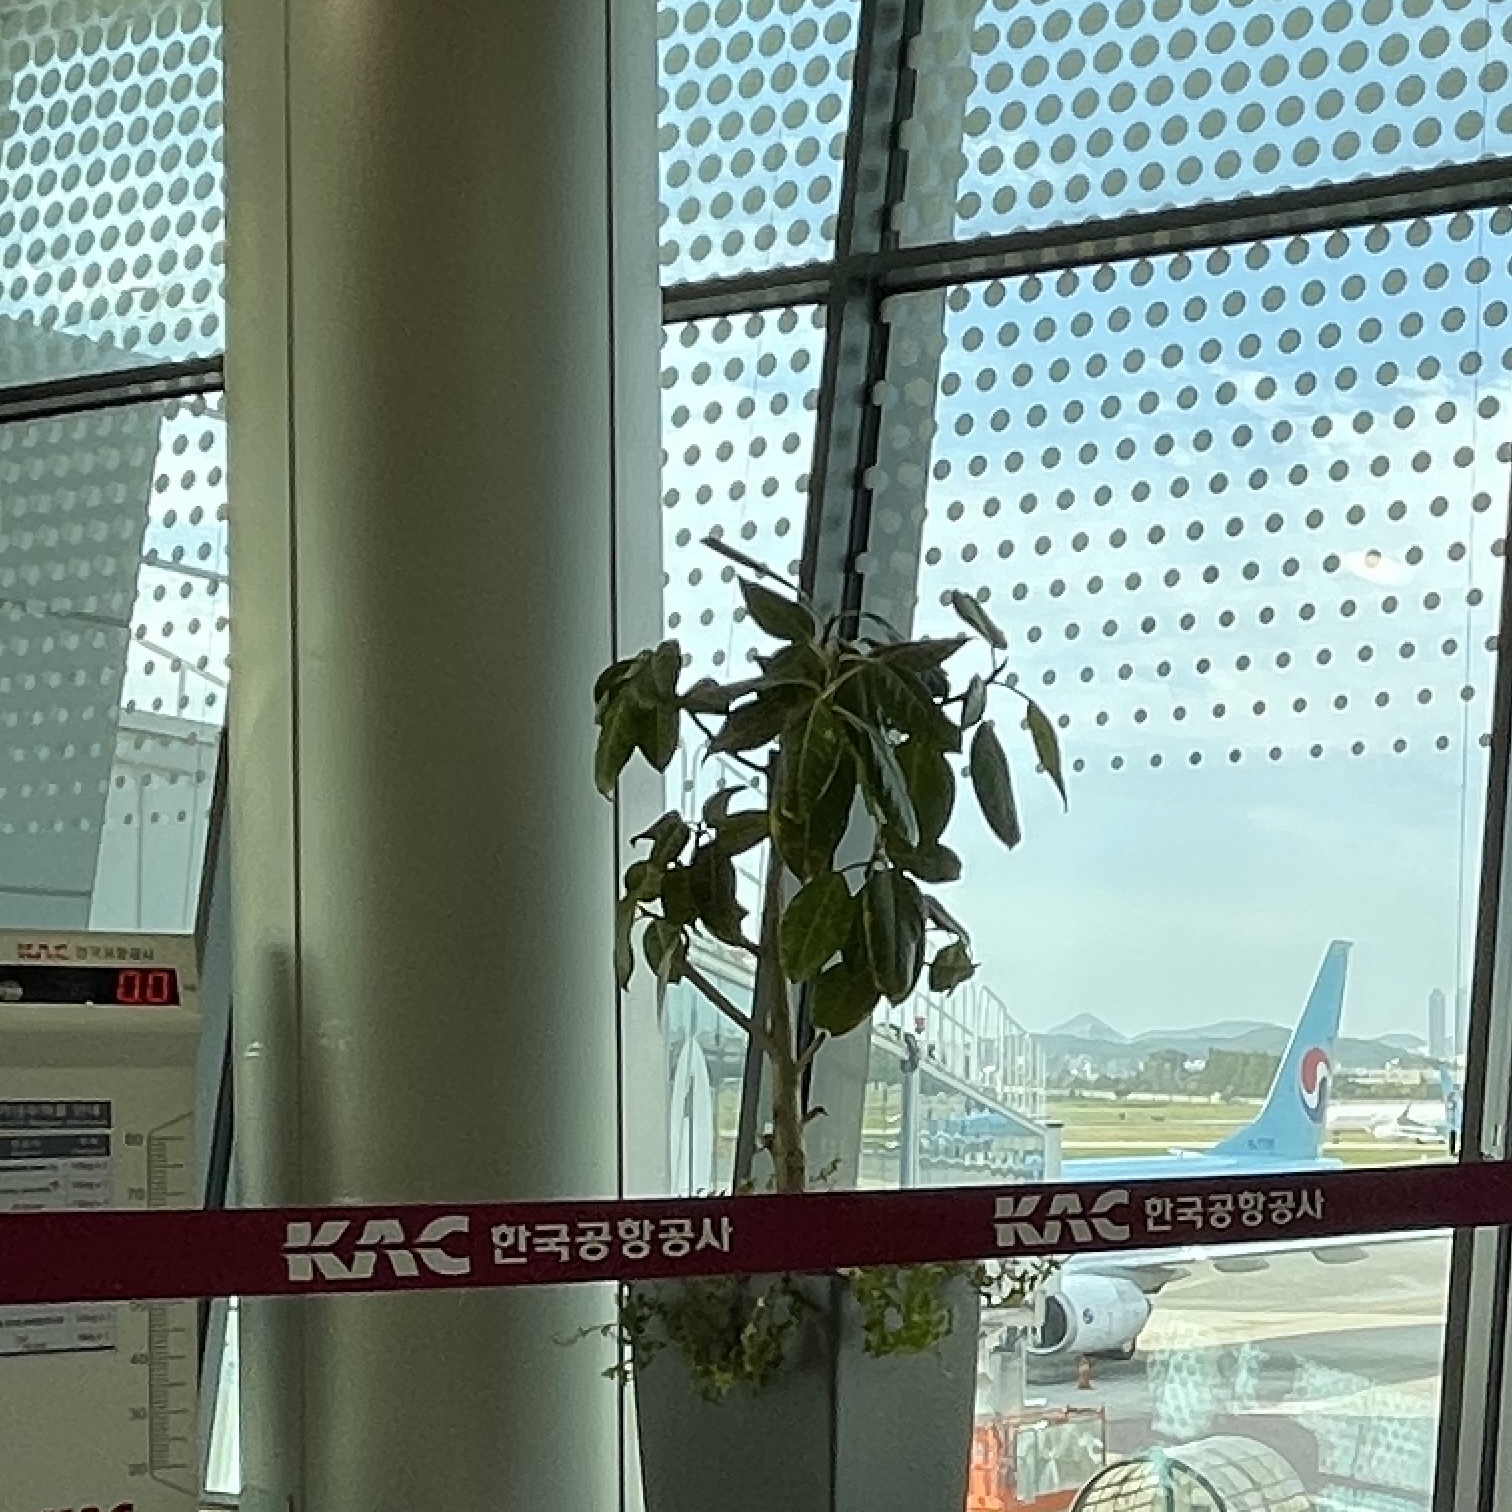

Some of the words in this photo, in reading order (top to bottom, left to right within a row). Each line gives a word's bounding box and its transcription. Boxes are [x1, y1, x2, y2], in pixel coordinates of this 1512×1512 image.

[283, 1215, 471, 1282] KAC
[490, 1216, 733, 1265] 한국공항공사
[993, 1188, 1133, 1248] KAC
[1144, 1189, 1325, 1232] 한국공항공사
